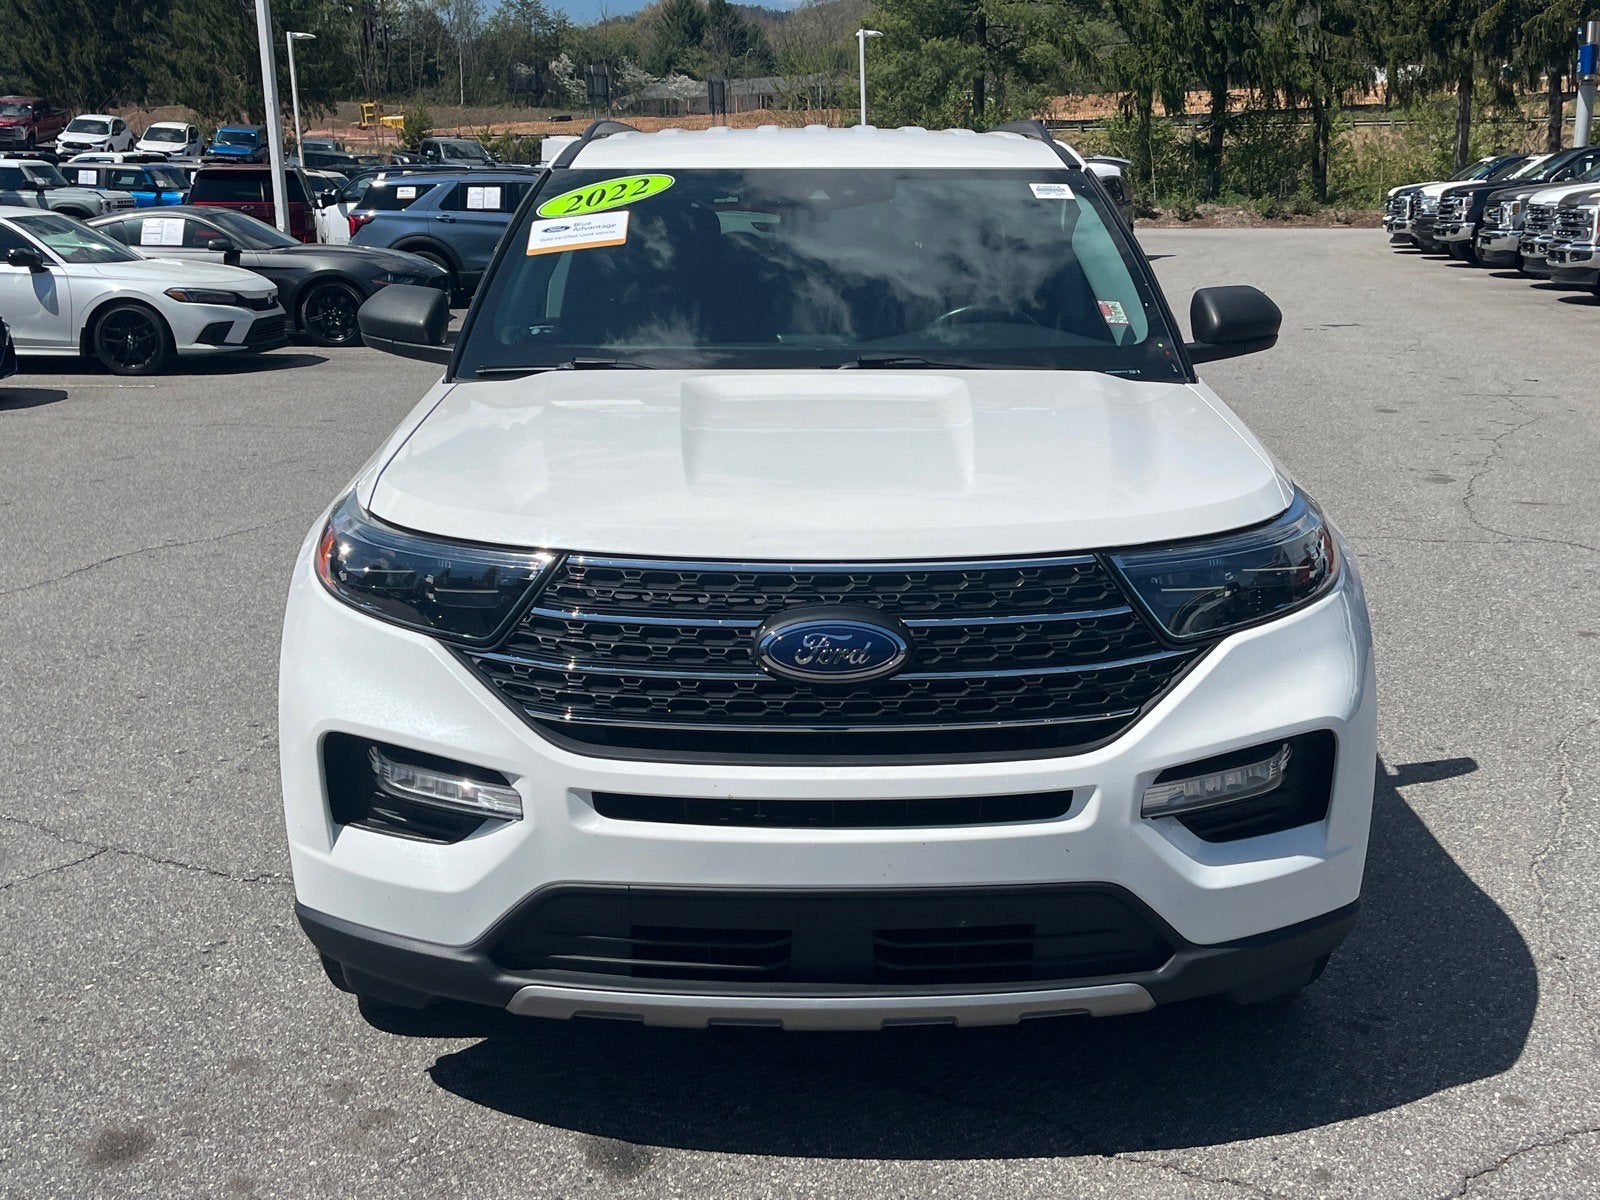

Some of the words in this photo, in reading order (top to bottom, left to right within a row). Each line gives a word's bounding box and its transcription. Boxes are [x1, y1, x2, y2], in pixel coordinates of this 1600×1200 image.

[563, 178, 650, 214] 2022
[572, 223, 617, 232] Advantage
[794, 632, 872, 665] Ford
